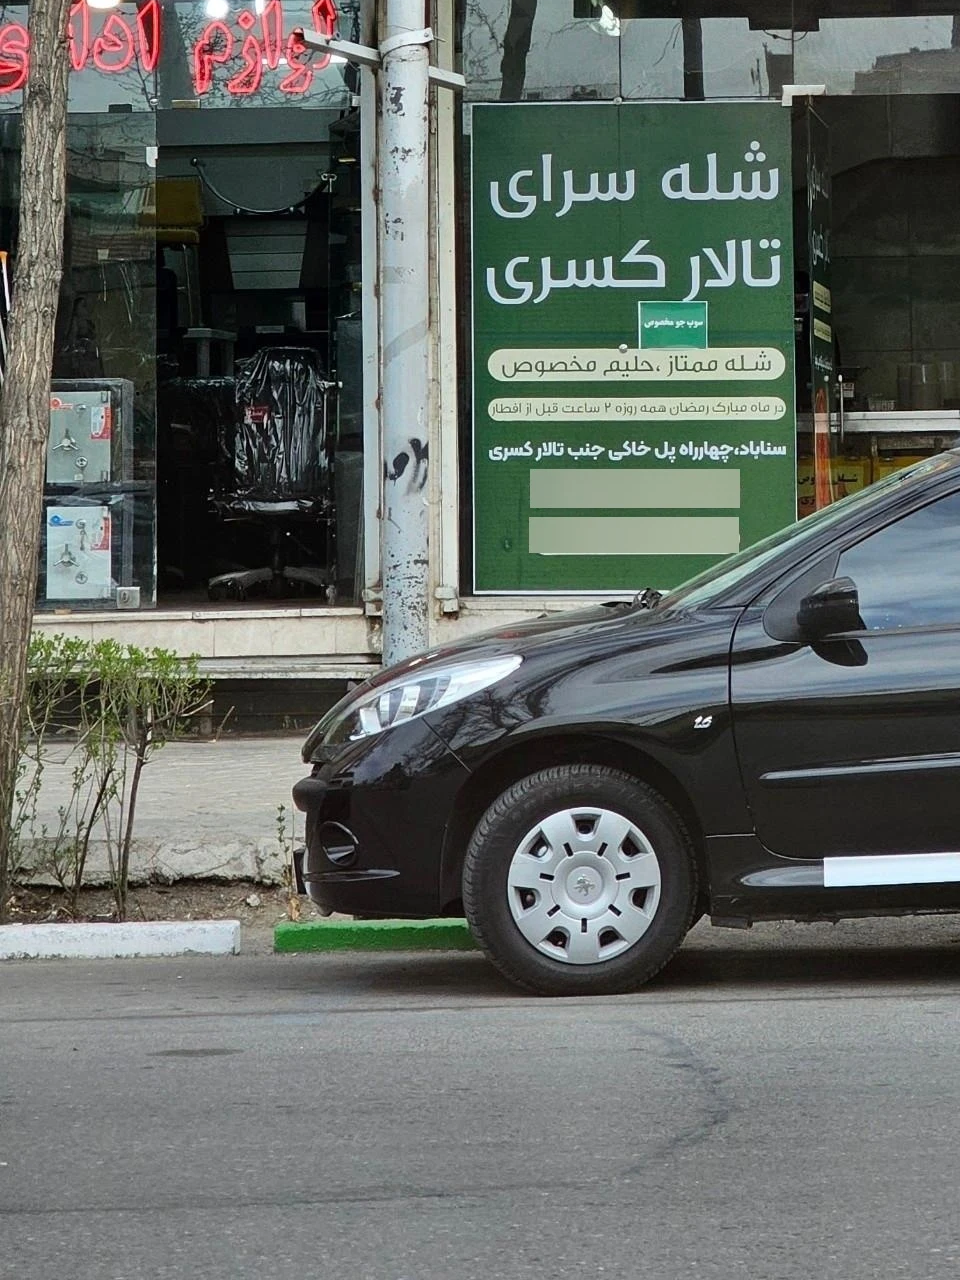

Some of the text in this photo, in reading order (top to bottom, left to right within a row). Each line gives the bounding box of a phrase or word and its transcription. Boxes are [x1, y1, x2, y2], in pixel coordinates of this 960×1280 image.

[661, 140, 780, 202] شله
[489, 152, 636, 218] سرای
[486, 239, 667, 305] کسری
[681, 237, 782, 302] تالار
[501, 355, 597, 378] مخصوص
[666, 354, 718, 377] ممتاز
[725, 350, 772, 372] شله
[491, 402, 522, 417] افطار
[525, 402, 533, 417] از
[535, 402, 559, 417] قبل
[561, 402, 600, 414] ساعت
[615, 402, 637, 415] روزه
[640, 404, 667, 414] همه
[669, 402, 710, 416] رمضان
[711, 402, 748, 416] مبارک
[750, 402, 770, 413] ماه
[488, 440, 534, 462] کسری
[535, 441, 565, 462] تالار
[567, 443, 606, 460] جنب
[608, 440, 652, 461] خاکی
[654, 440, 677, 464] پل
